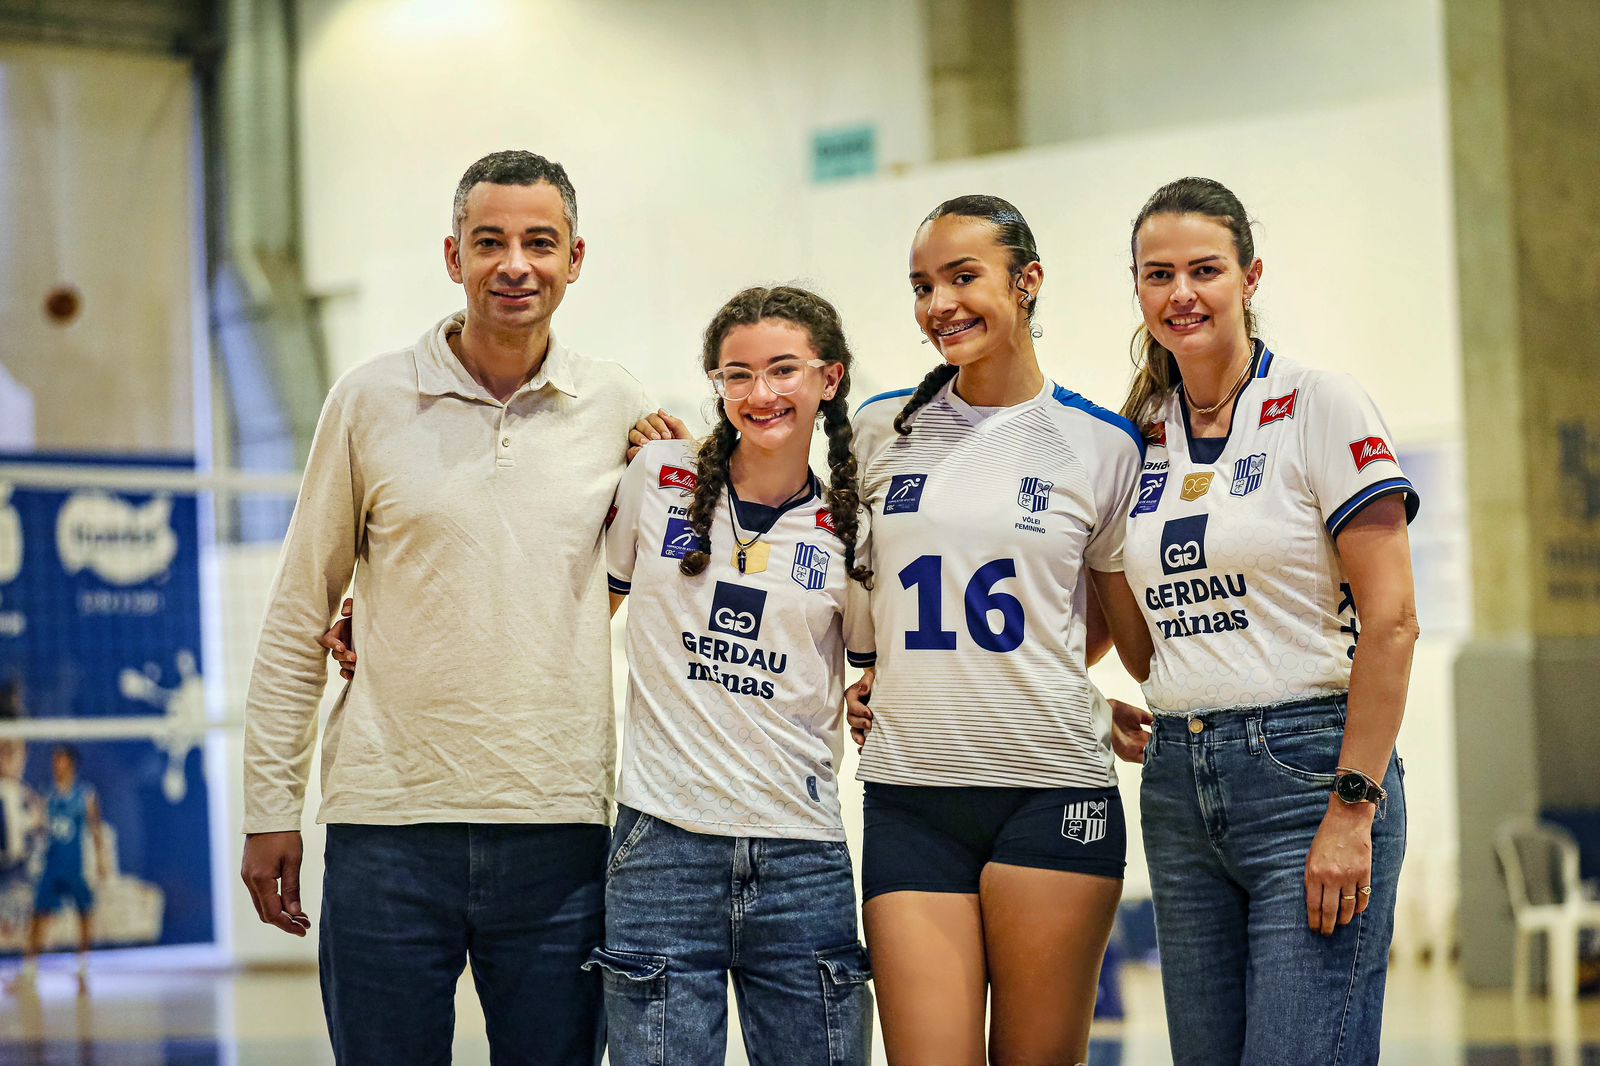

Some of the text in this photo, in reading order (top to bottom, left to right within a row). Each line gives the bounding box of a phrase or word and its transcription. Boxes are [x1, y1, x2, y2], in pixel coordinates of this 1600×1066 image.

[1015, 523, 1046, 534] FEMININO
[1022, 516, 1041, 525] VÔLEI
[898, 555, 1025, 653] 16
[1145, 573, 1247, 611] GERDAU
[1156, 609, 1249, 640] minas
[682, 631, 787, 674] GERDAU
[687, 661, 775, 700] minas
